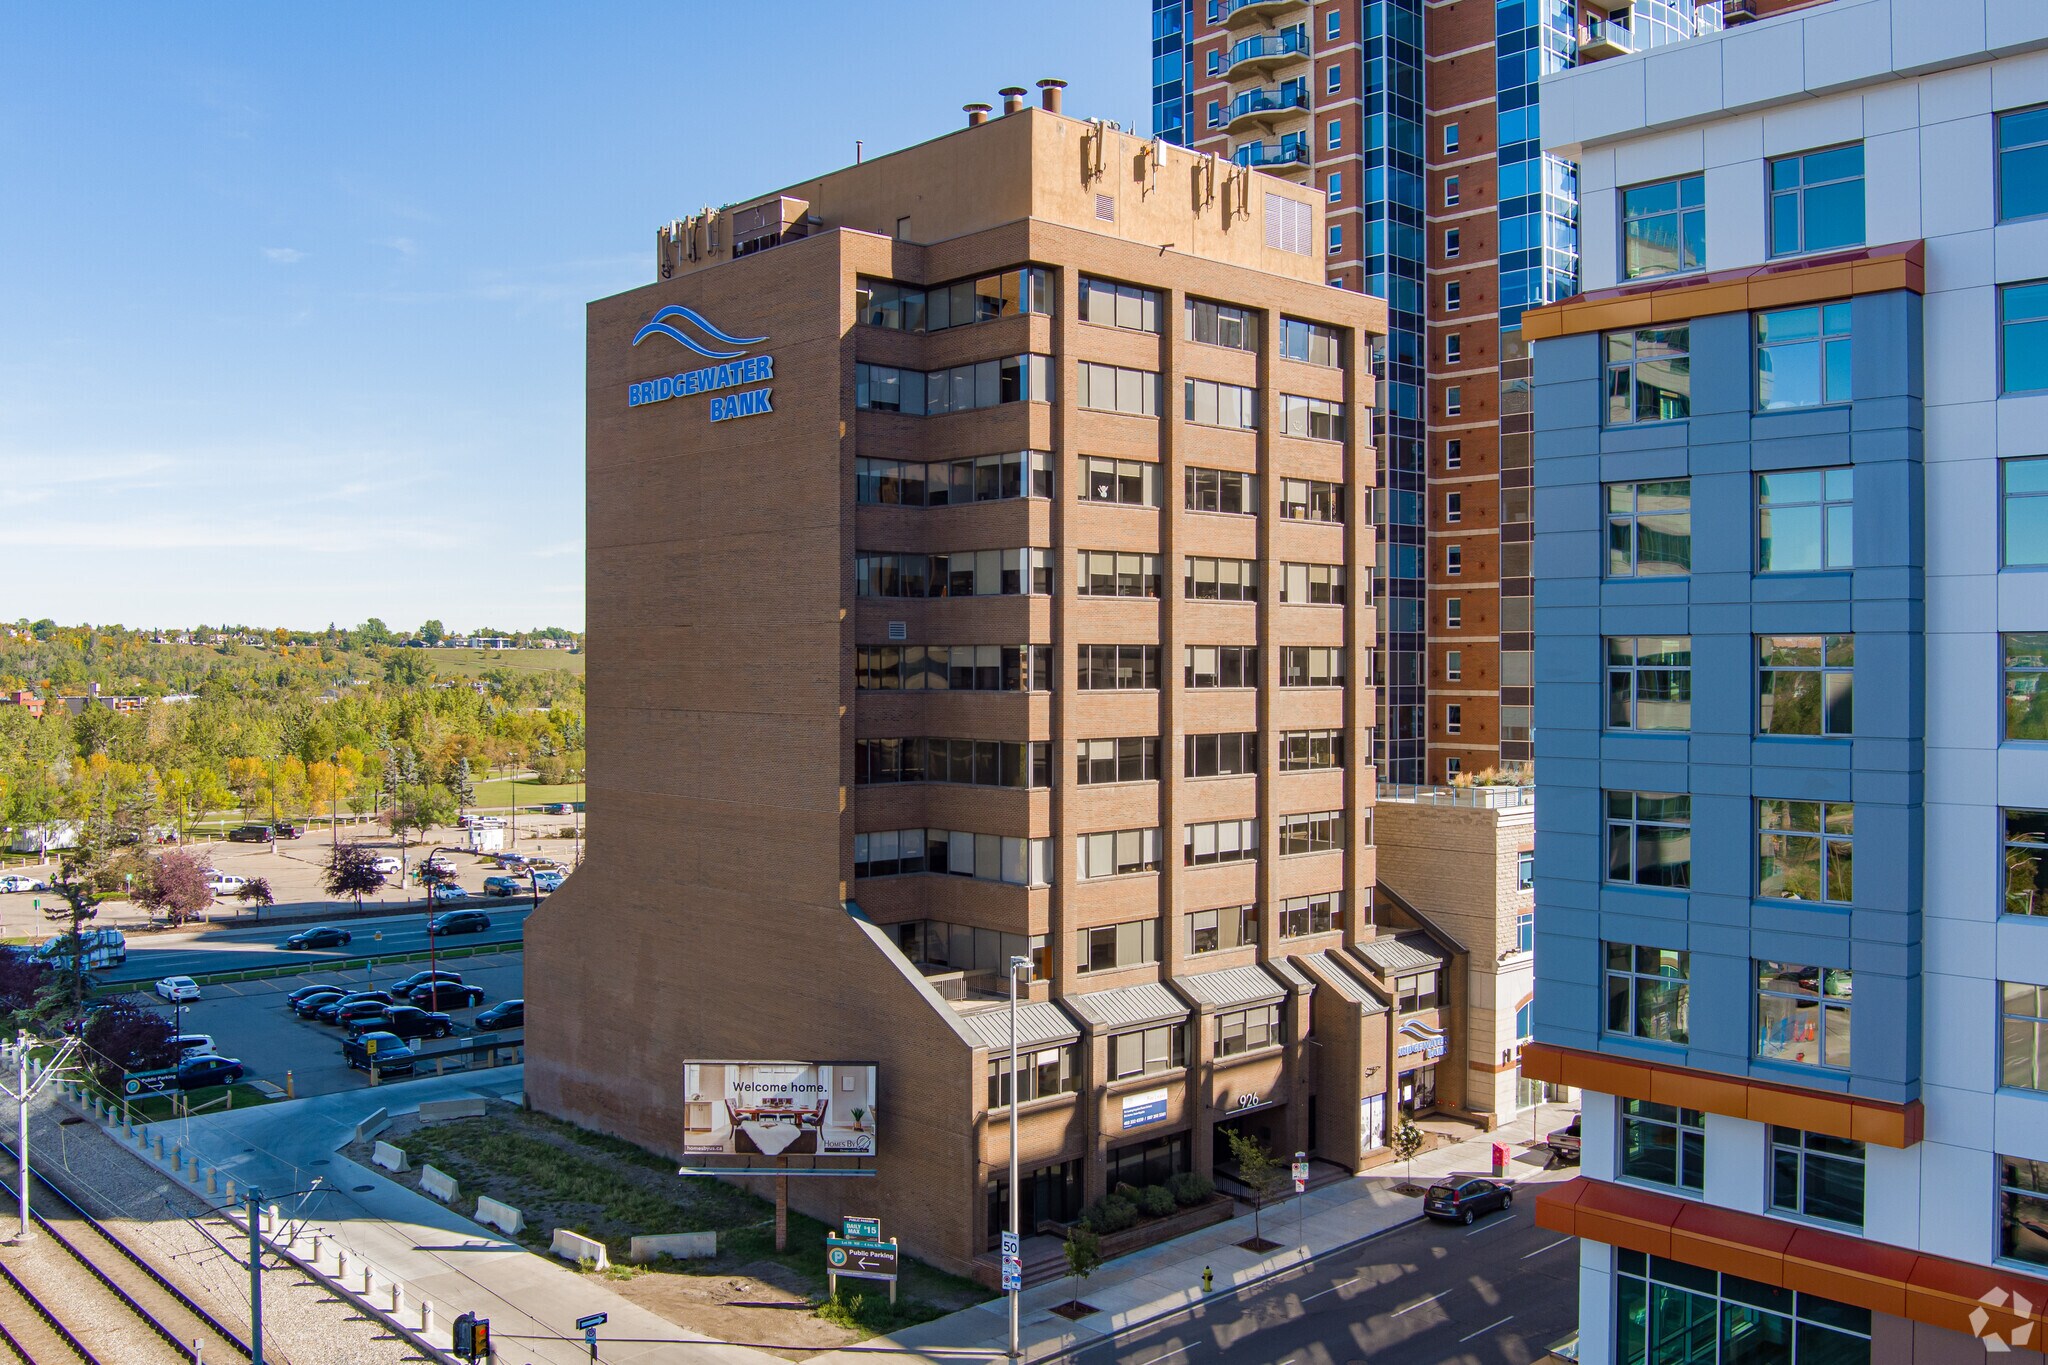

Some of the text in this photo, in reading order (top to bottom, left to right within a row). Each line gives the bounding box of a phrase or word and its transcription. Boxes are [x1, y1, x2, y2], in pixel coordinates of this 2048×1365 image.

[629, 355, 774, 407] BRIDGEWATER
[710, 387, 773, 423] BANK
[1397, 1036, 1448, 1057] BRIDGEWATER
[733, 1081, 828, 1093] Welcome home.
[1240, 1092, 1258, 1108] 926
[824, 1139, 846, 1147] HOMES
[864, 1225, 877, 1234] $15
[1004, 1241, 1017, 1253] 50
[834, 1251, 843, 1263] P
[870, 1251, 894, 1260] Parking
